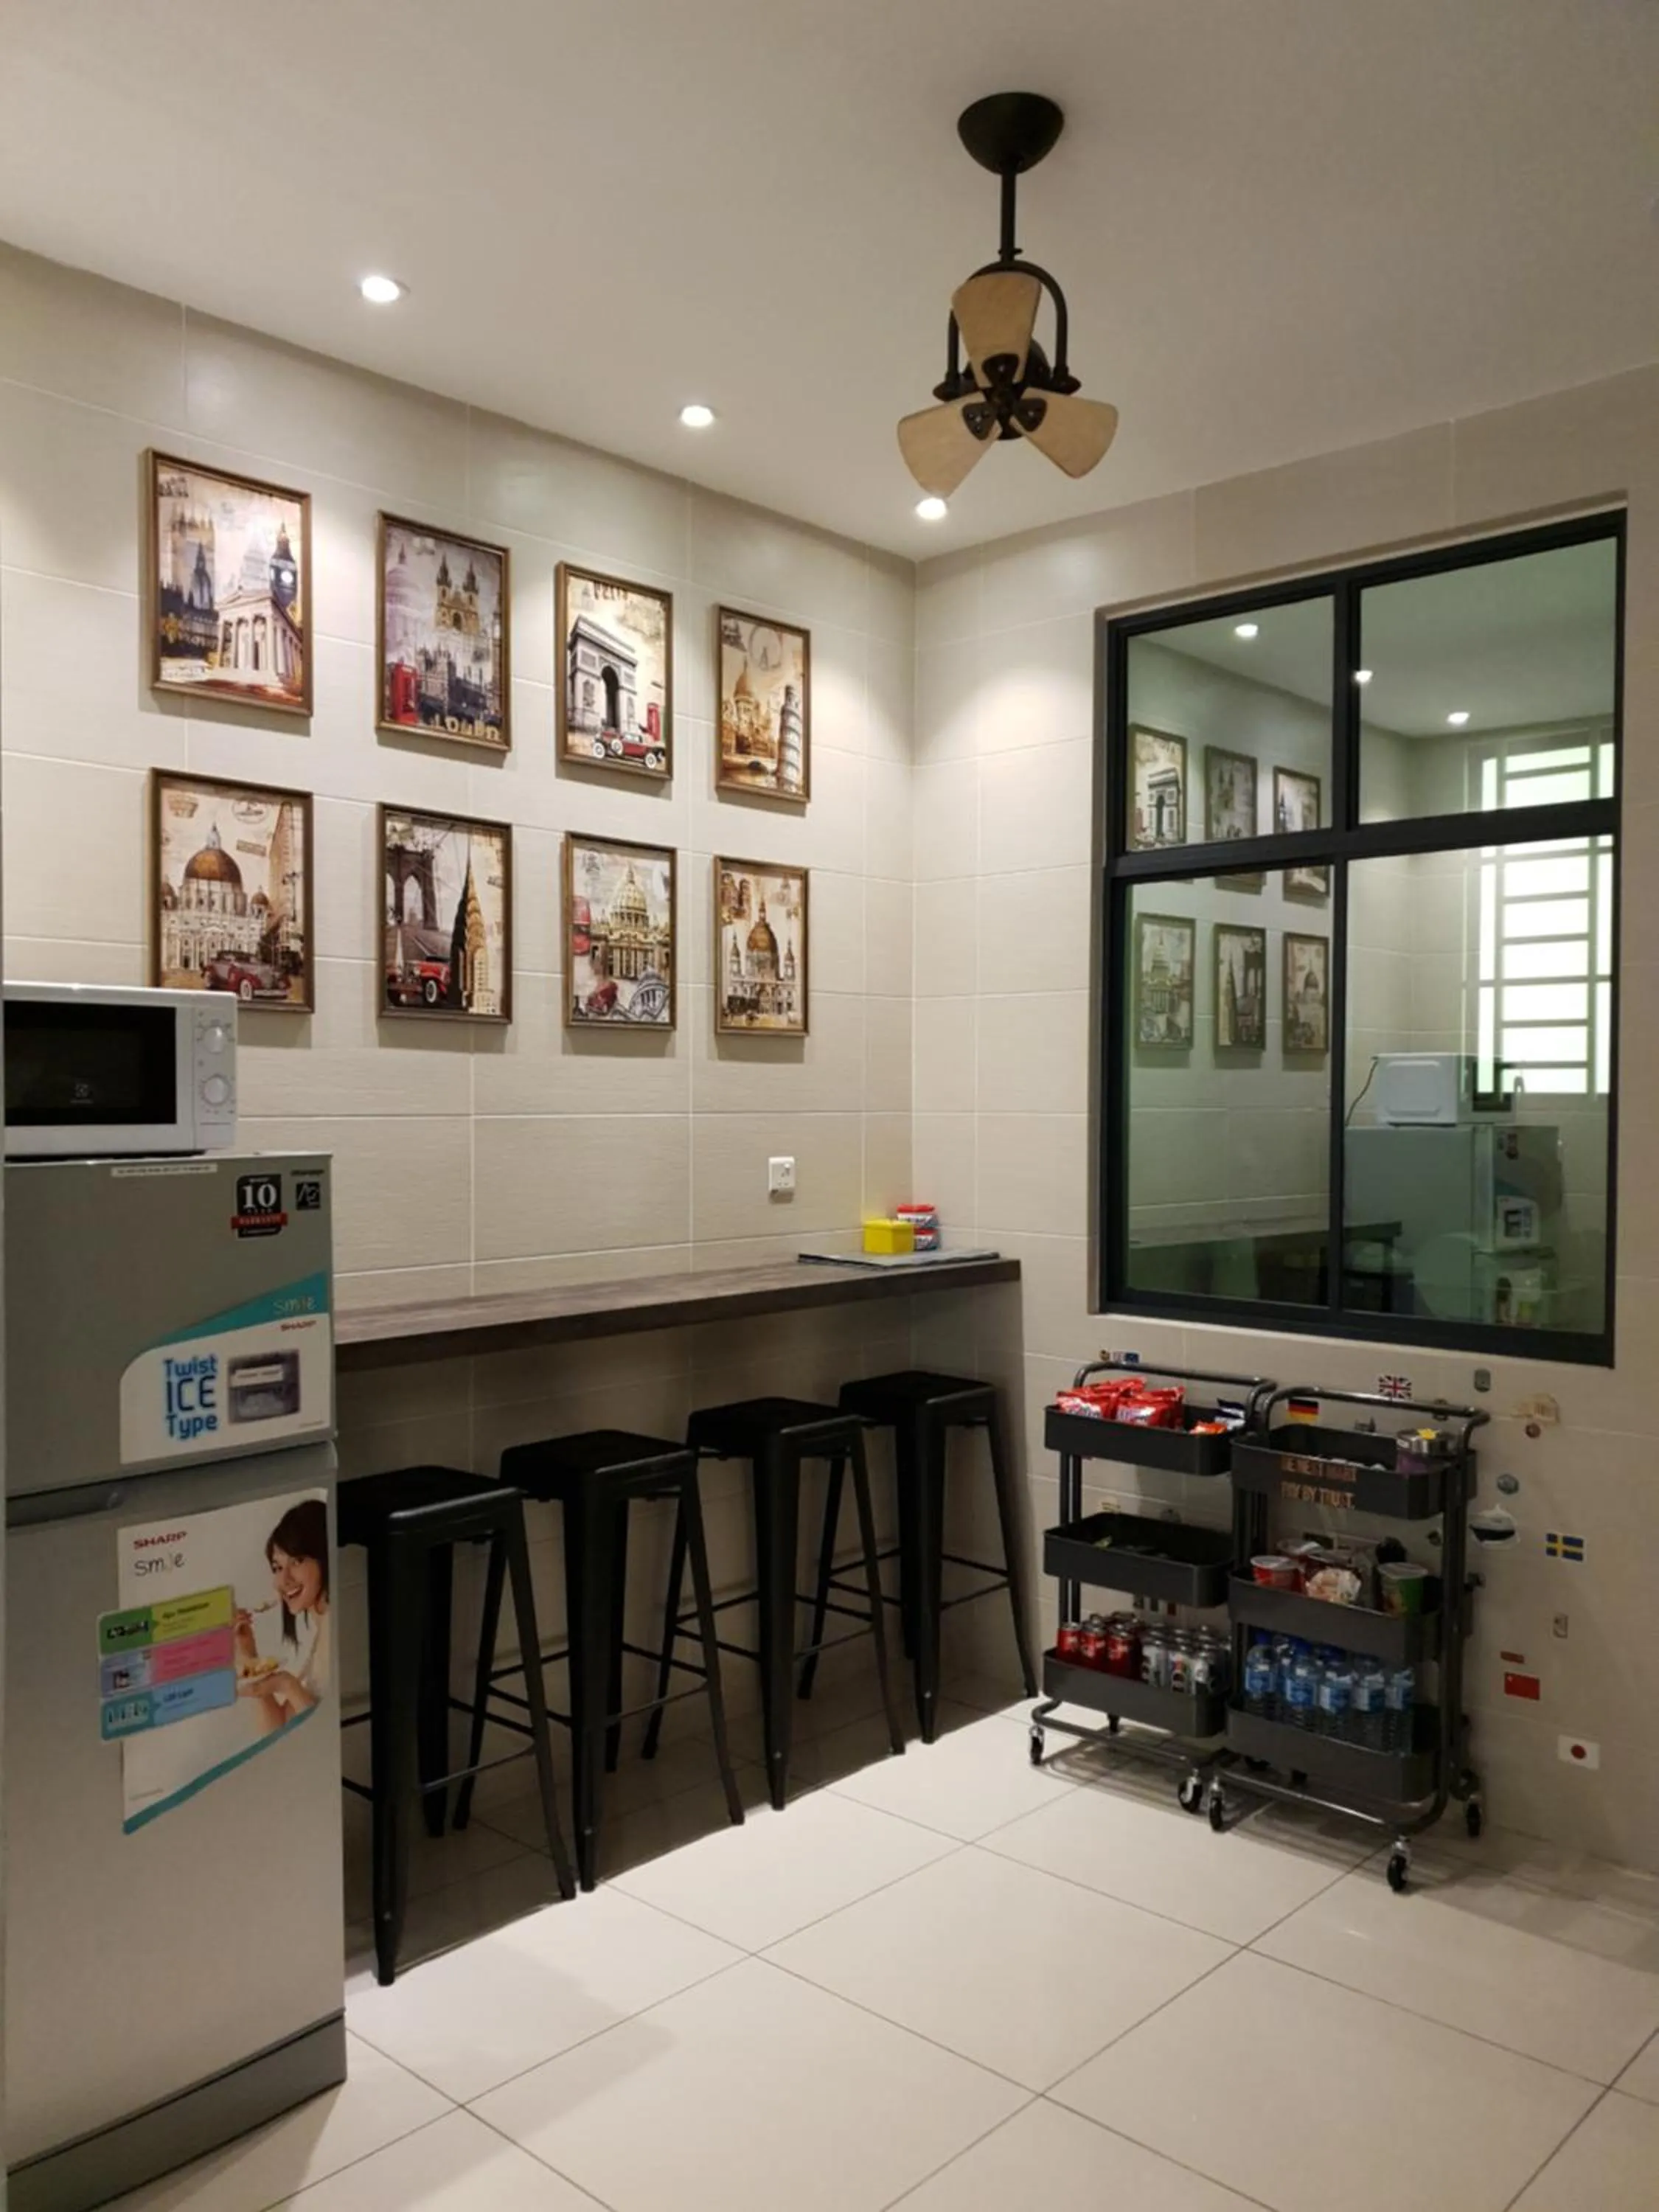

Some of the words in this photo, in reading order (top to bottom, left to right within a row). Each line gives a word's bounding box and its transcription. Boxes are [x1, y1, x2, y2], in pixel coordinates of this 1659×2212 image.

[242, 1183, 277, 1208] 10
[164, 1354, 218, 1379] Twist
[167, 1375, 216, 1413] ICE
[166, 1413, 218, 1440] Type
[133, 1531, 187, 1551] SHARP
